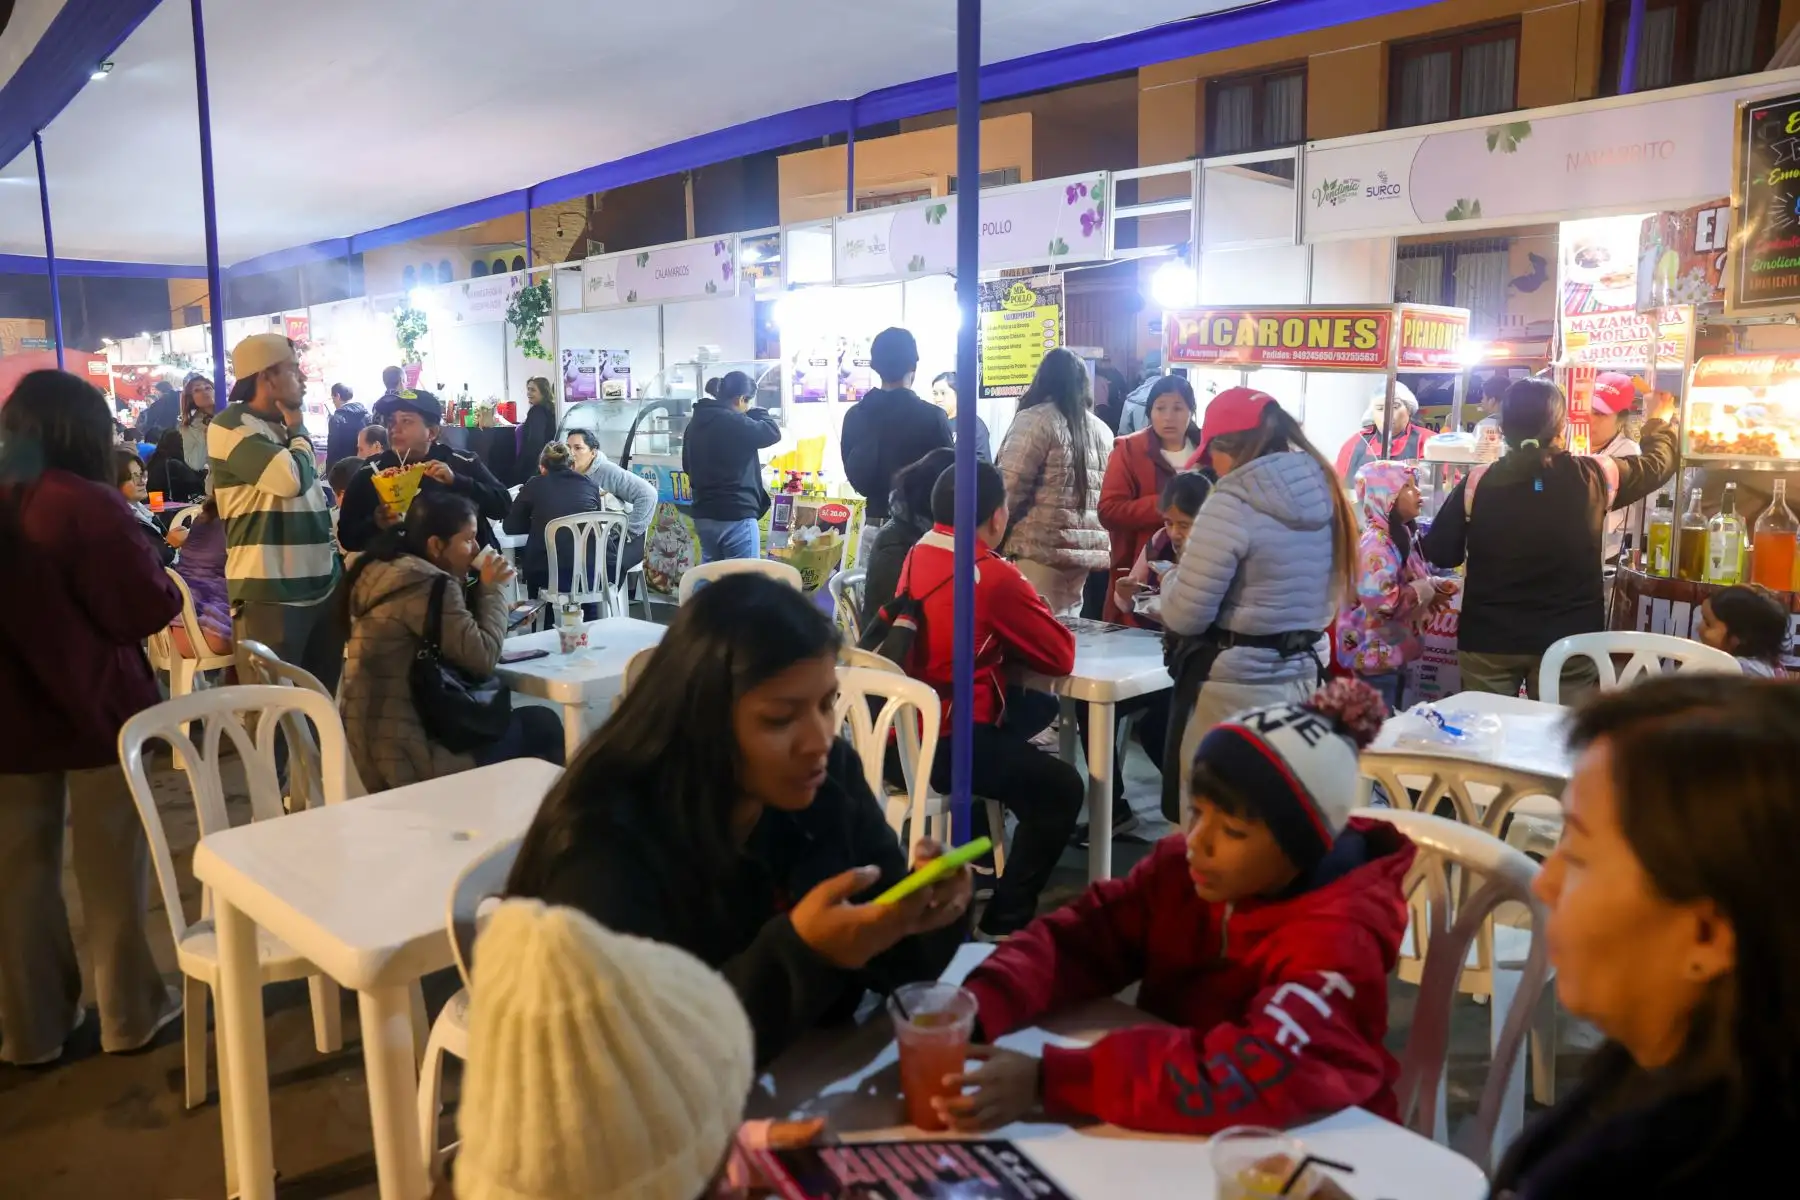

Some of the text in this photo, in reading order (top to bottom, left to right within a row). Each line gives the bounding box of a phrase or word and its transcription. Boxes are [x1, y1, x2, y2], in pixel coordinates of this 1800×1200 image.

[1366, 184, 1401, 198] SURCO
[982, 219, 1012, 236] POLLO
[1178, 317, 1379, 349] PICARONES
[830, 510, 847, 518] 20.00
